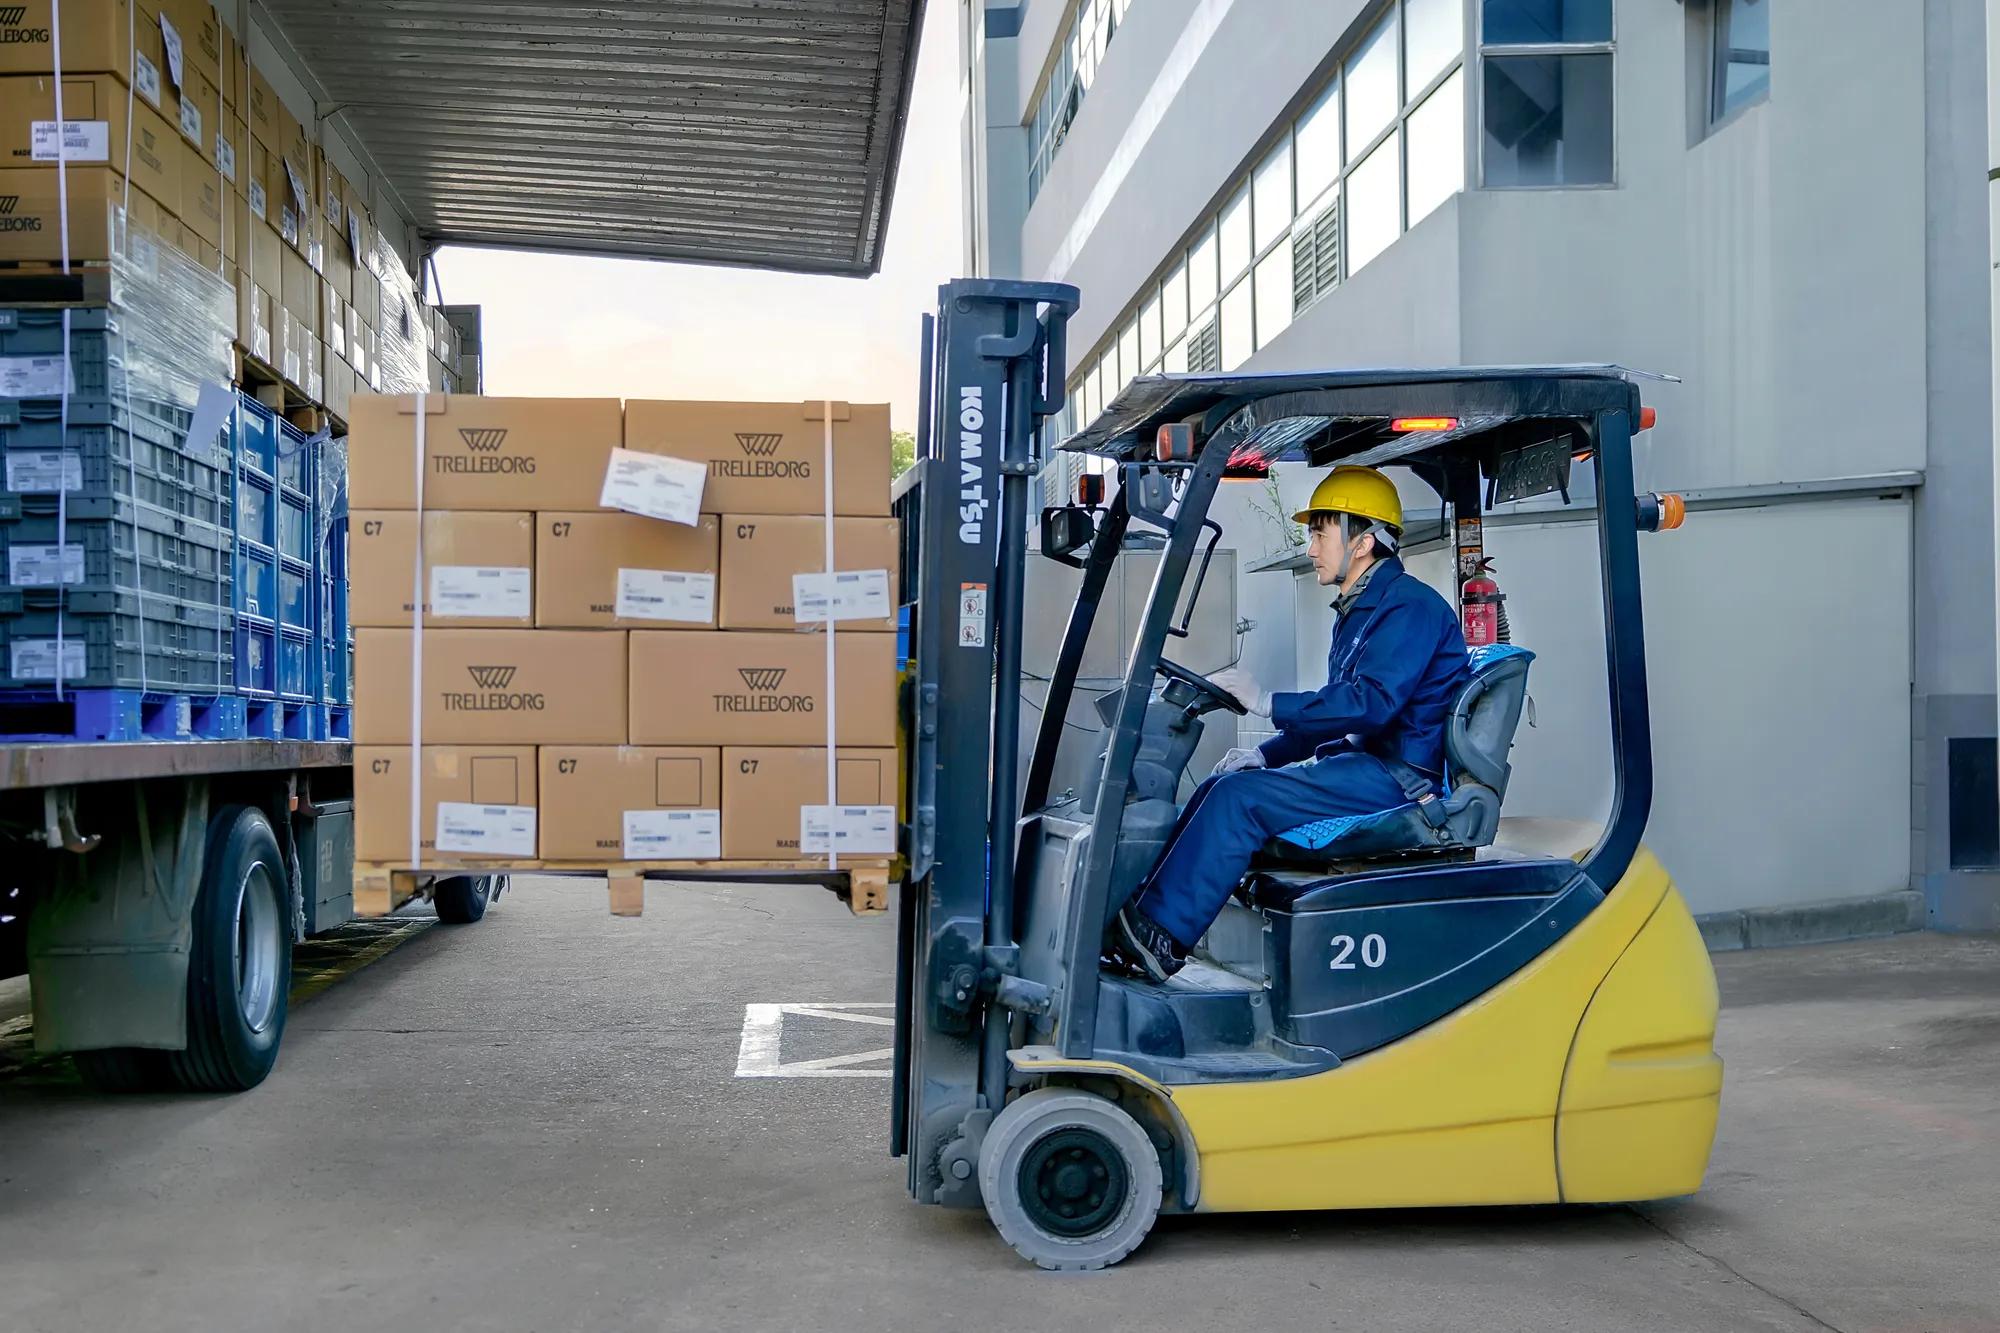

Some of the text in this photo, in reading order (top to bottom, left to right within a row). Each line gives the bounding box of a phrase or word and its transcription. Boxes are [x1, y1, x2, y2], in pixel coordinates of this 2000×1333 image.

[433, 455, 536, 474] TRELLEBORG
[708, 459, 810, 478] TRELLEBORG
[959, 386, 988, 544] KOMATSU
[364, 521, 383, 536] C7
[552, 522, 571, 537] C7
[737, 524, 756, 539] C7
[403, 604, 427, 612] MAE
[442, 693, 545, 711] TRELLEBORG
[713, 695, 814, 713] TRELLEBORG
[372, 760, 391, 774] C7
[558, 760, 577, 774] C7
[740, 760, 759, 774] C7
[596, 840, 619, 849] MADE
[776, 840, 800, 849] MADE
[1330, 933, 1387, 969] 20
